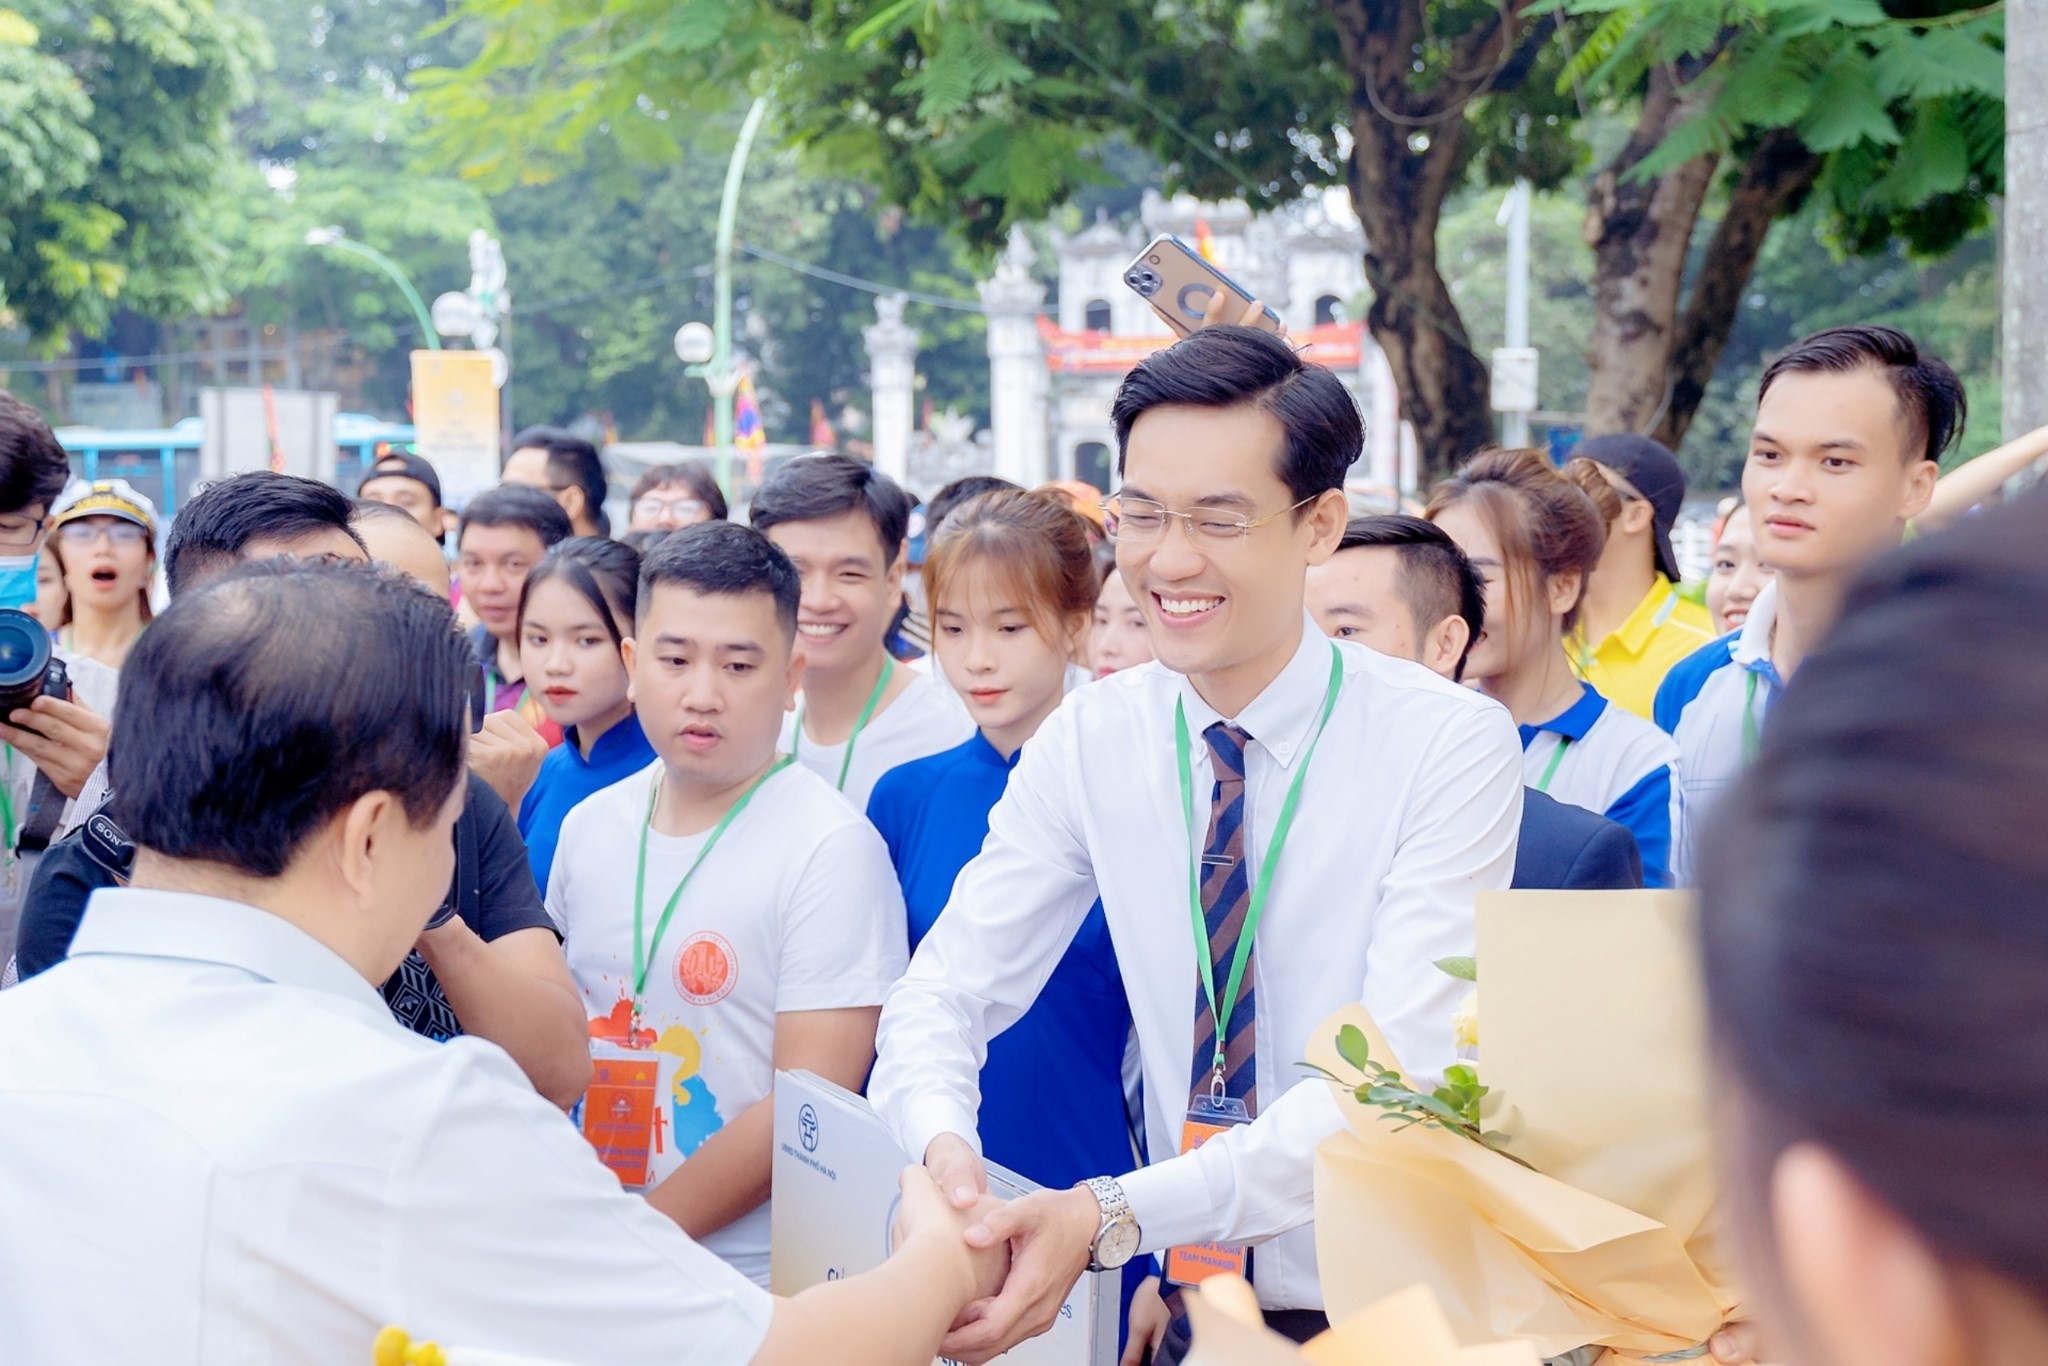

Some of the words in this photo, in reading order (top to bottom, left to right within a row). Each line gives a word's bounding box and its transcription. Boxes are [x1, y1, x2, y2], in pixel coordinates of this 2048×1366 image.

[95, 822, 122, 846] SON
[1179, 1250, 1199, 1262] TEAM
[1200, 1255, 1236, 1270] MANAGER
